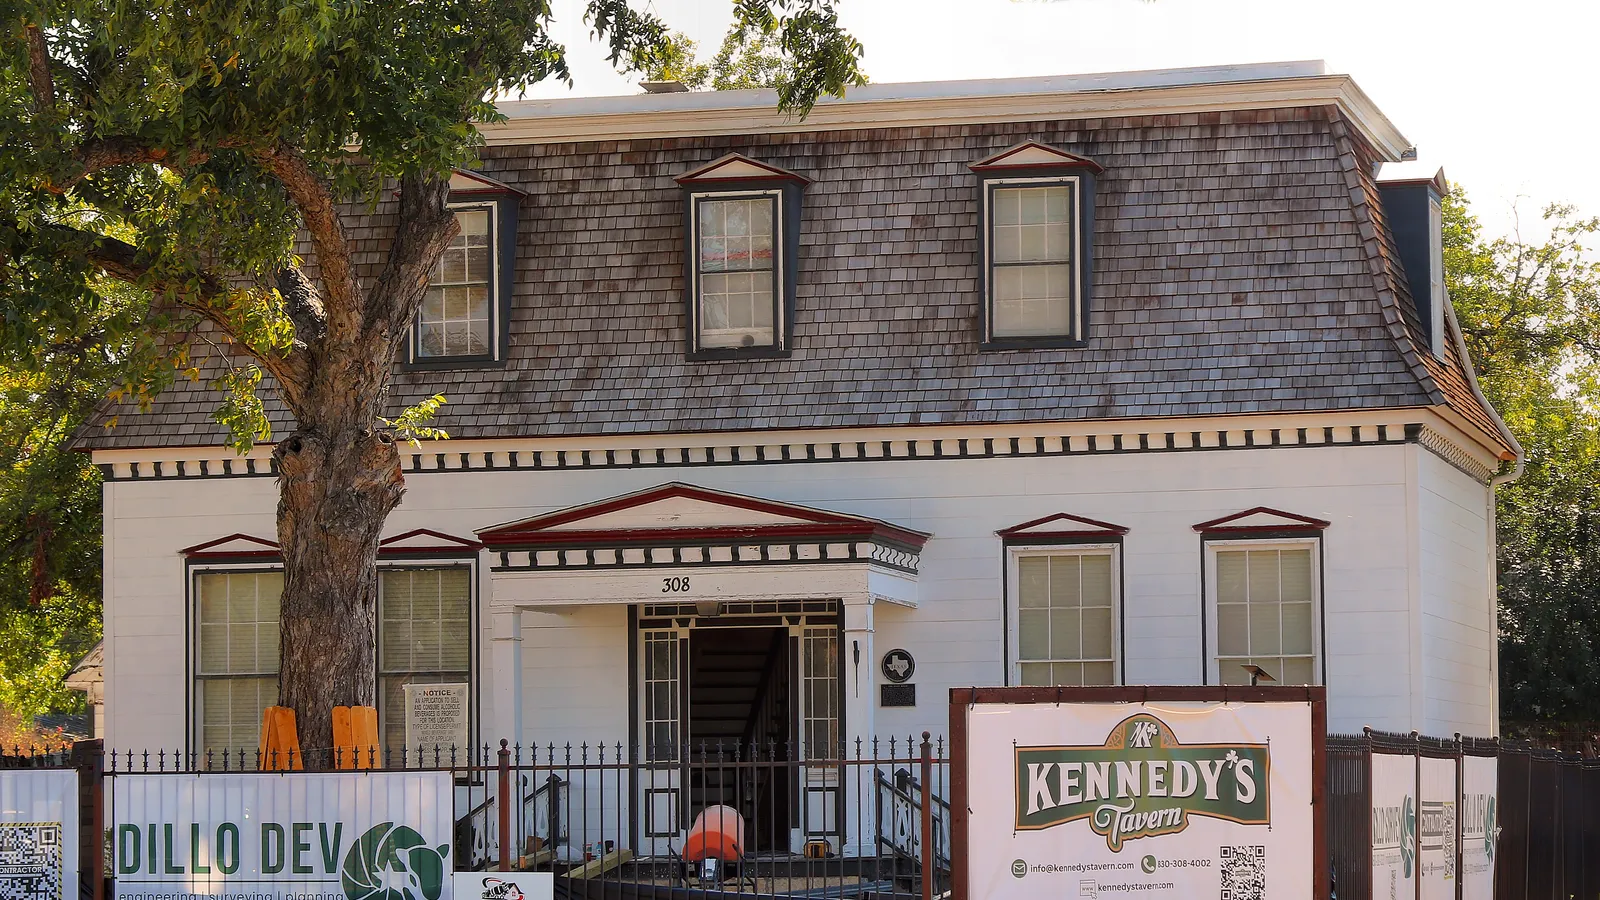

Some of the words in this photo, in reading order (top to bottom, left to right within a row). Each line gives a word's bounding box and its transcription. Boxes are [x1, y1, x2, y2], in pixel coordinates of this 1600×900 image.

[662, 577, 690, 592] 308
[1026, 751, 1257, 816] KENNEDY'S
[1095, 798, 1181, 844] Tavern
[119, 822, 240, 874] DILLO
[261, 822, 343, 874] DEV
[1030, 863, 1135, 874] info@kennedystavern.com
[119, 892, 196, 900] engineering
[209, 892, 272, 900] surveying
[286, 892, 344, 900] planning
